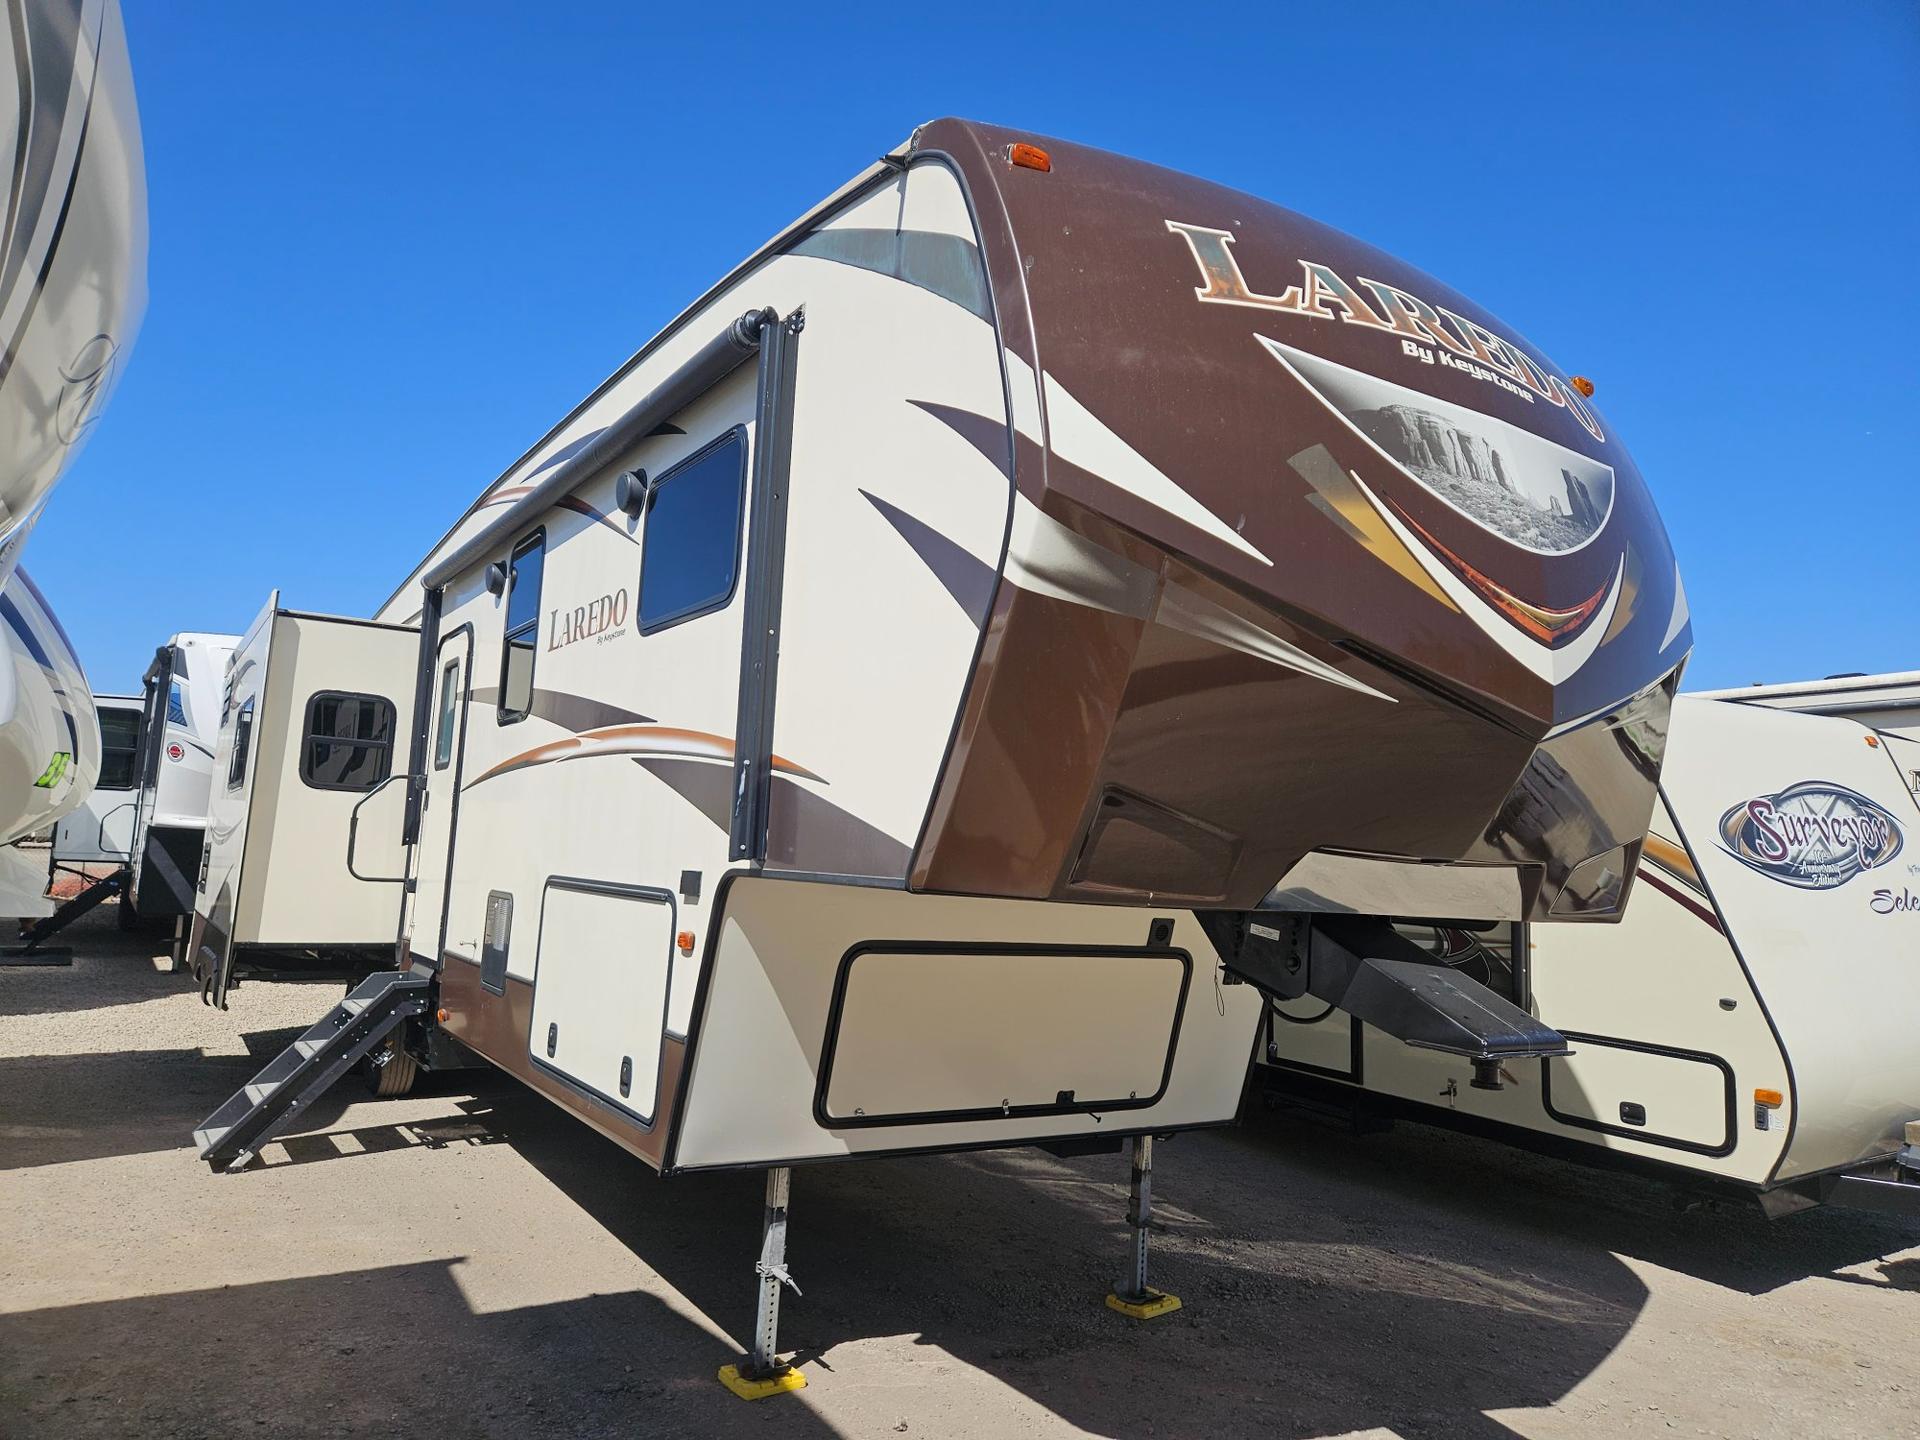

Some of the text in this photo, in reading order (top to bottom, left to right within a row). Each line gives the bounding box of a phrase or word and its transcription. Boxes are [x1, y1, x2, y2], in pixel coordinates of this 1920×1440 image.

[1165, 220, 1605, 443] LAREDO
[1401, 339, 1535, 404] By Keystone
[547, 587, 628, 653] LAREDO
[1746, 798, 1889, 870] Surveyor
